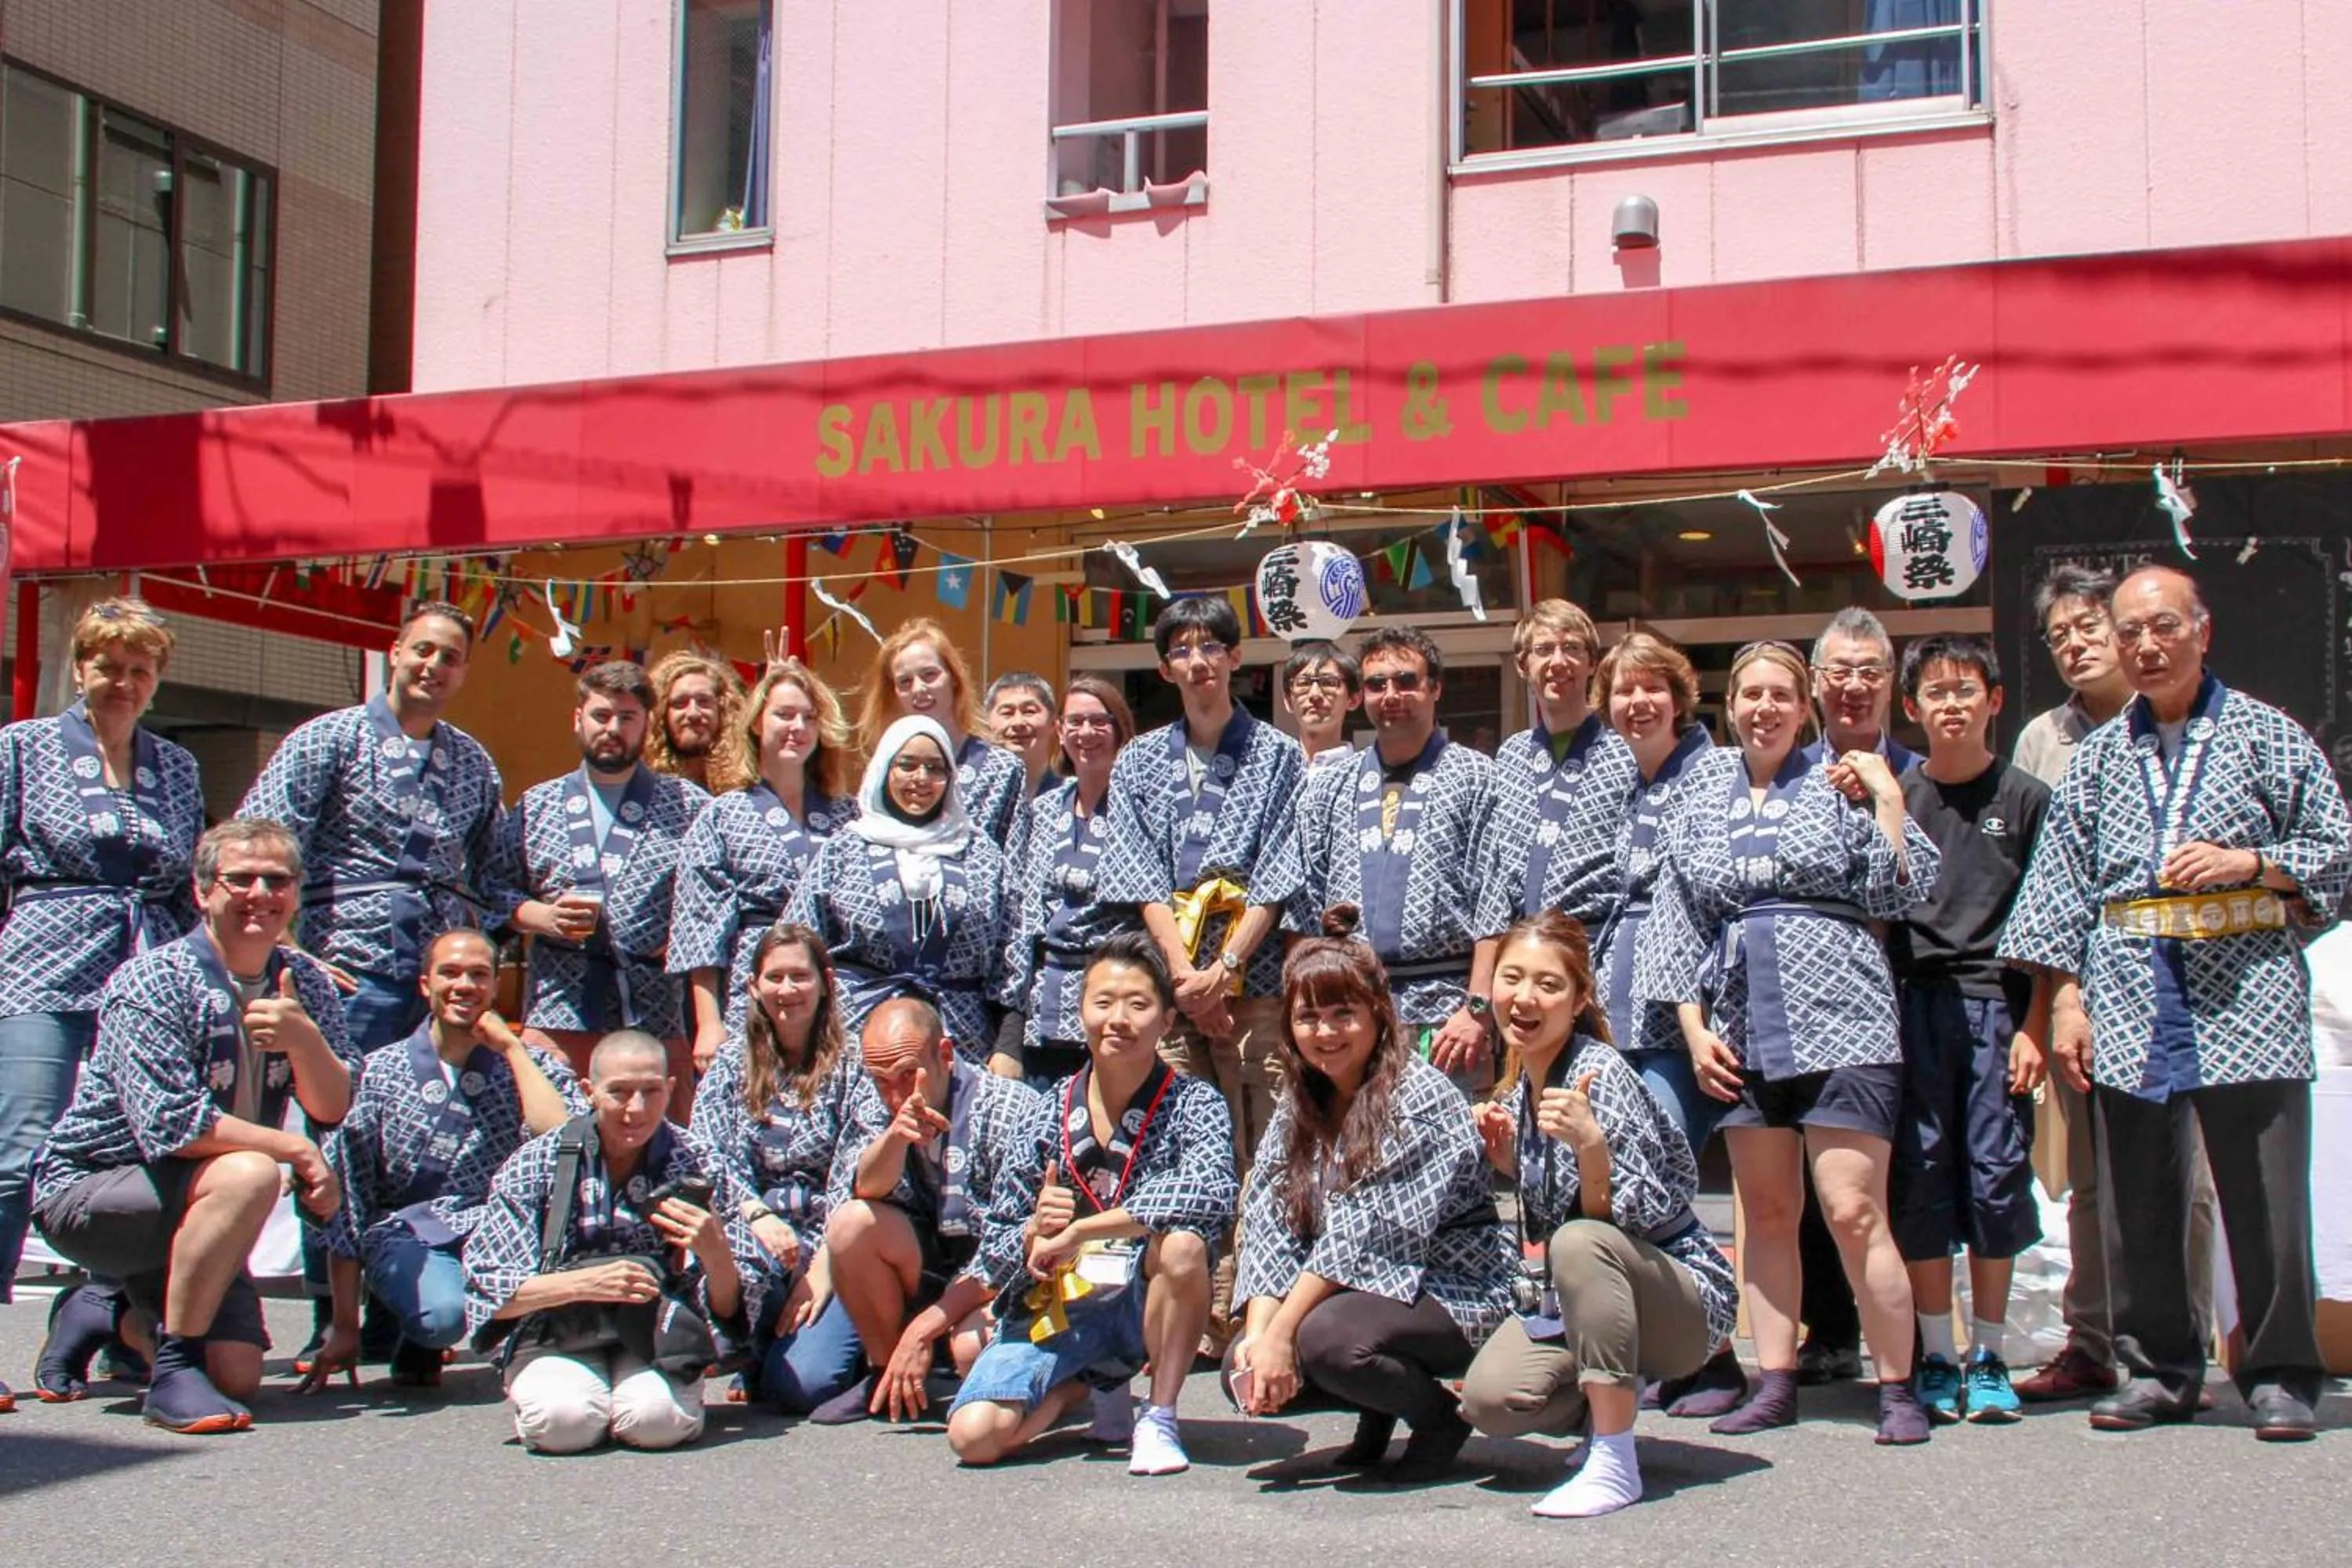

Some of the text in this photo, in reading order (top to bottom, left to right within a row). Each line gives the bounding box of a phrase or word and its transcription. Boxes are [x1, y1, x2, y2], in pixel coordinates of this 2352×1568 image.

[815, 340, 1690, 478] SAKURA HOTEL & CAFE
